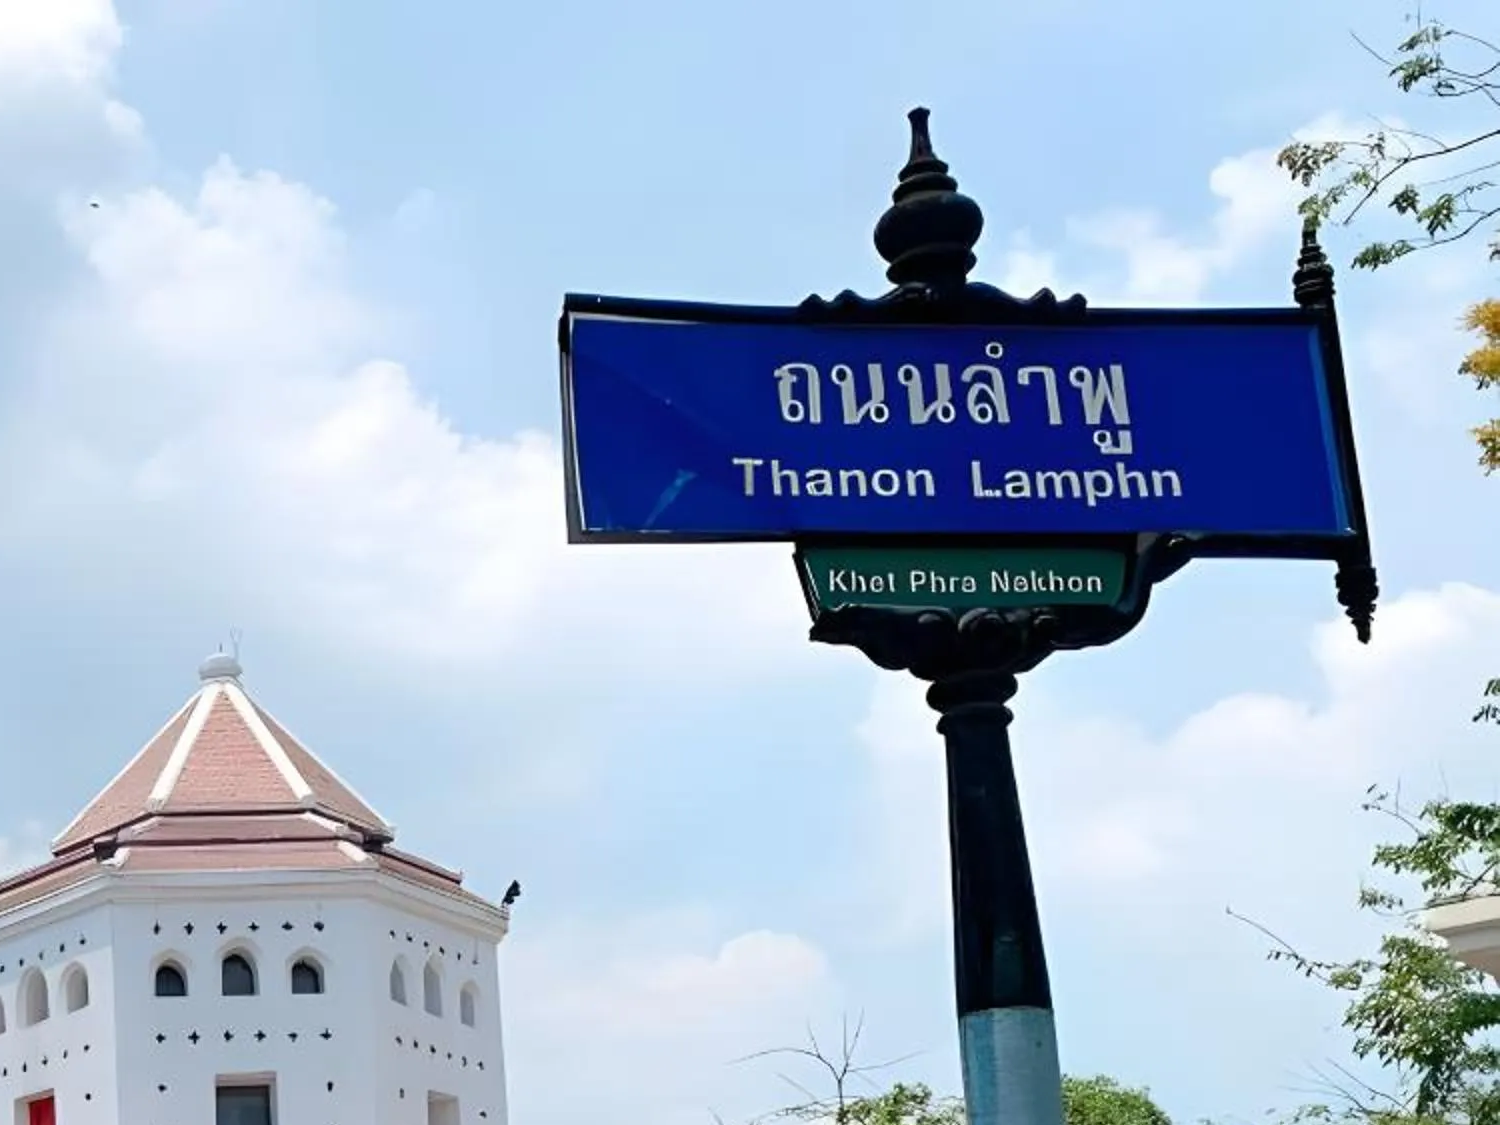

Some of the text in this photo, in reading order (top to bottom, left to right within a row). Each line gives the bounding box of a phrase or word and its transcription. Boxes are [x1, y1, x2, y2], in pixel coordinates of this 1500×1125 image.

[773, 341, 1133, 455] ถนนลำพู
[732, 457, 936, 498] Thanon
[828, 569, 1102, 593] Khet Phra Nakhon
